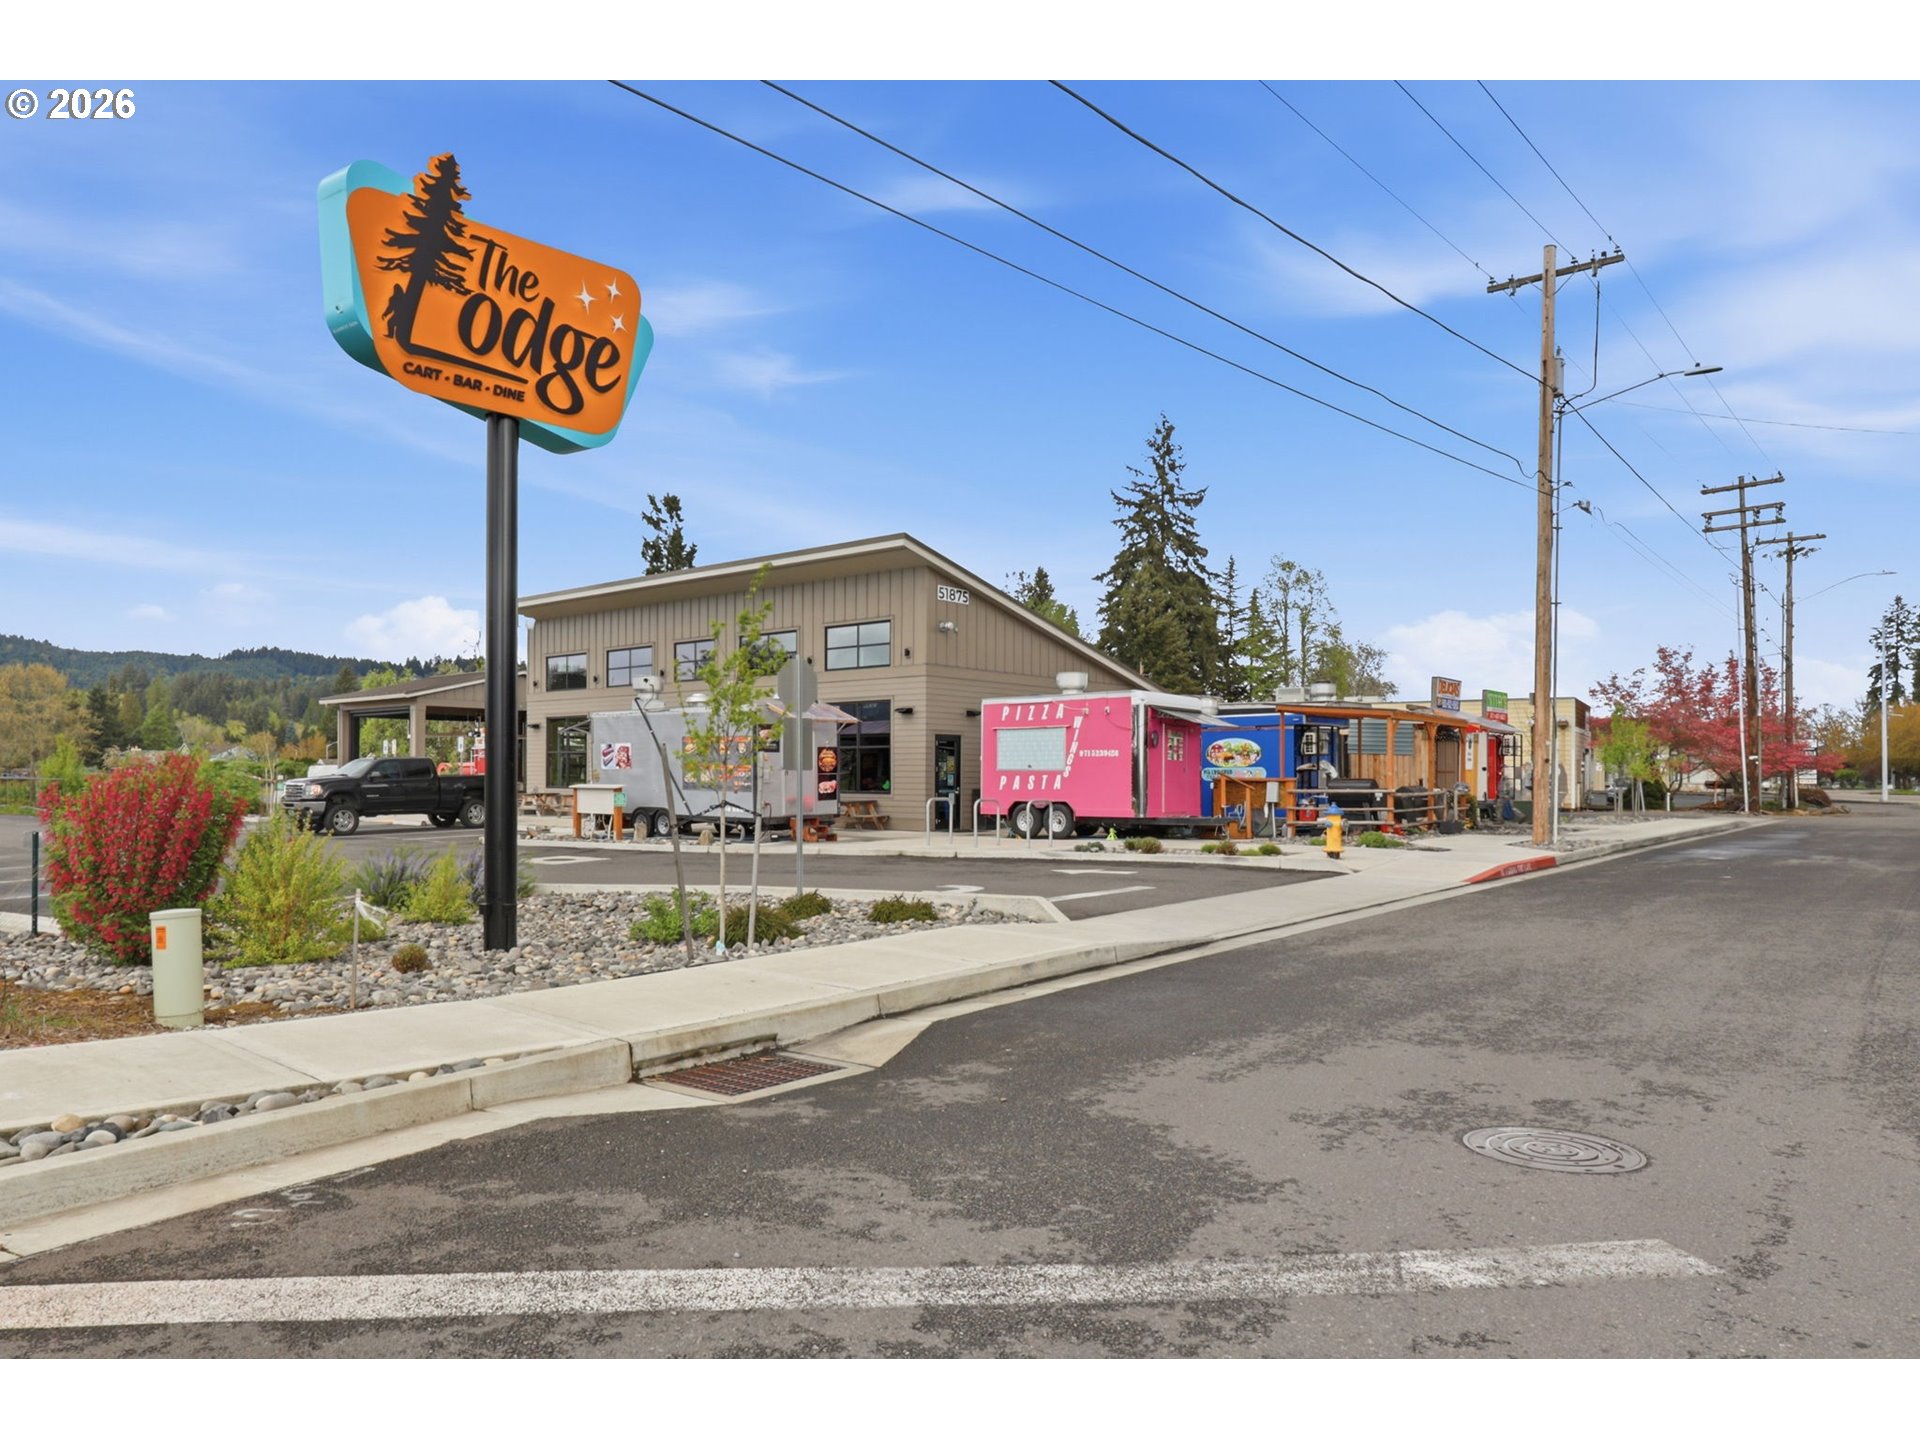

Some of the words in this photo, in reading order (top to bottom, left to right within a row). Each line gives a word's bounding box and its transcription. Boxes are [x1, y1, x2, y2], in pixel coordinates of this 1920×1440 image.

[469, 234, 540, 302] The
[403, 361, 442, 381] CART
[453, 375, 483, 392] BAR
[493, 385, 526, 402] DINE
[938, 587, 969, 603] 51875
[1001, 703, 1065, 721] PIZZA
[1063, 716, 1083, 777] WINGS
[999, 774, 1062, 790] PASTA
